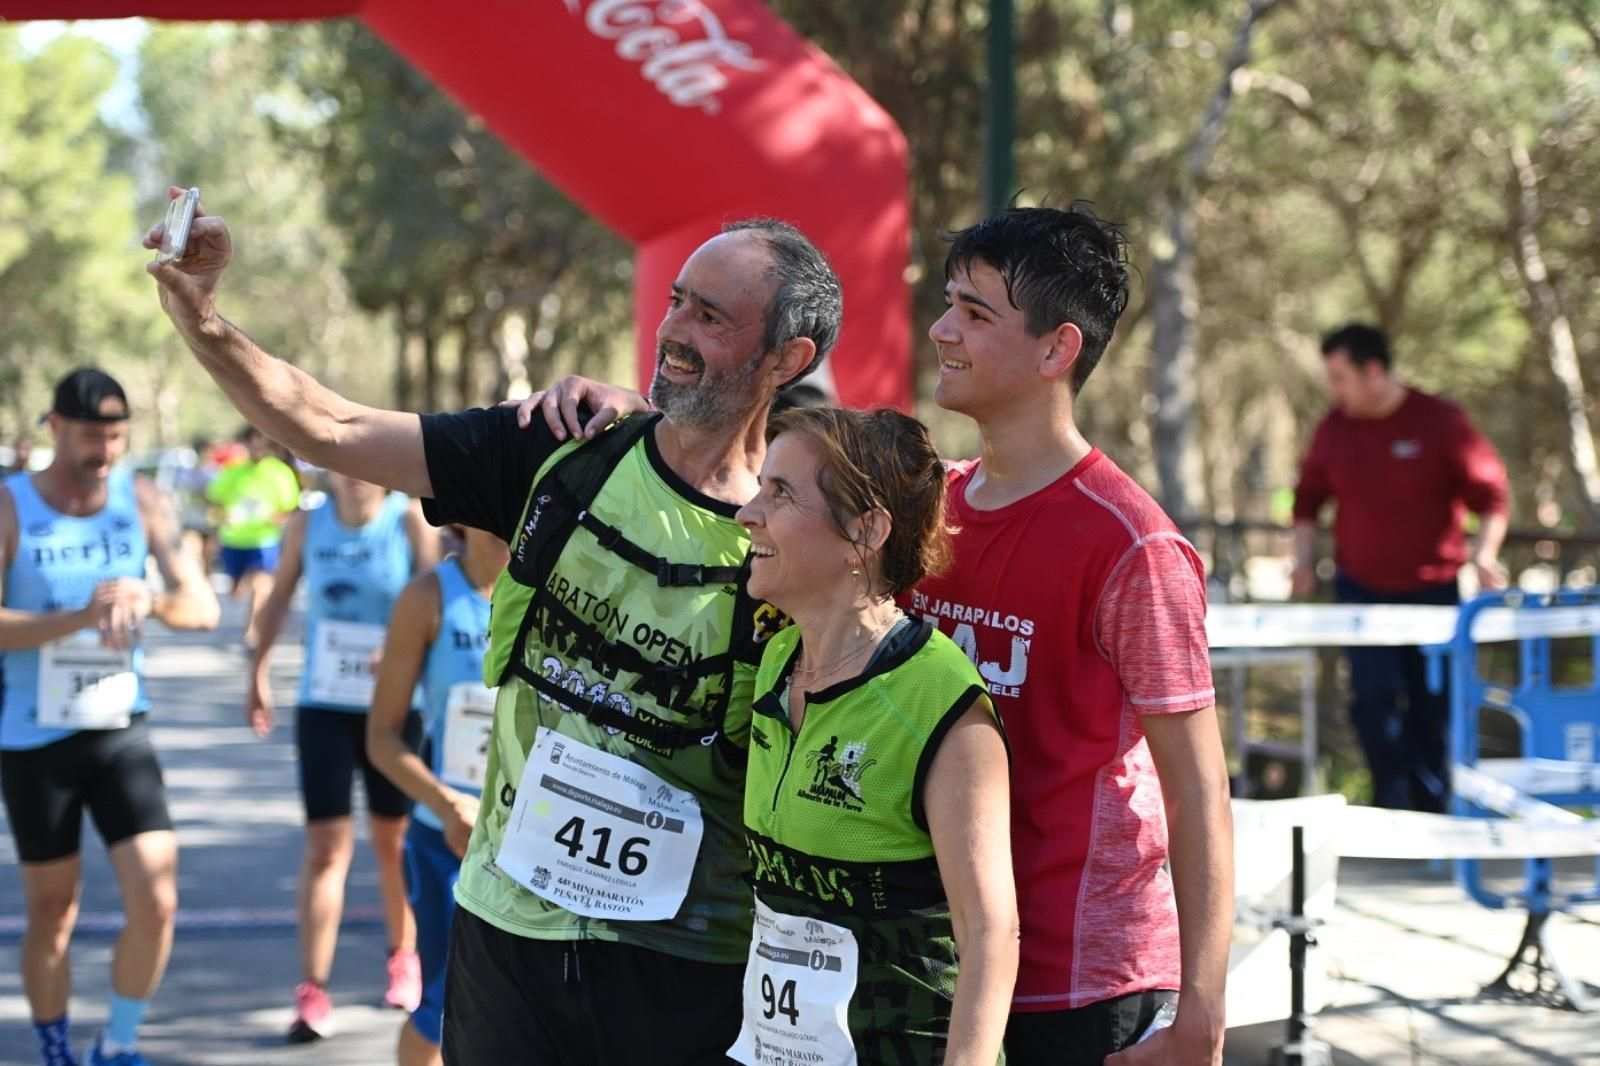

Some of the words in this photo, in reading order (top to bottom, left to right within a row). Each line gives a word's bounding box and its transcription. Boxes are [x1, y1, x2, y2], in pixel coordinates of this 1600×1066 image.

[546, 573, 629, 635] ARATÓN
[931, 600, 1035, 636] JARAPALOS
[564, 752, 611, 776] Ayuntamiento
[612, 771, 622, 780] de
[622, 774, 648, 791] Málaga
[554, 816, 651, 877] 416
[761, 973, 800, 1026] 94
